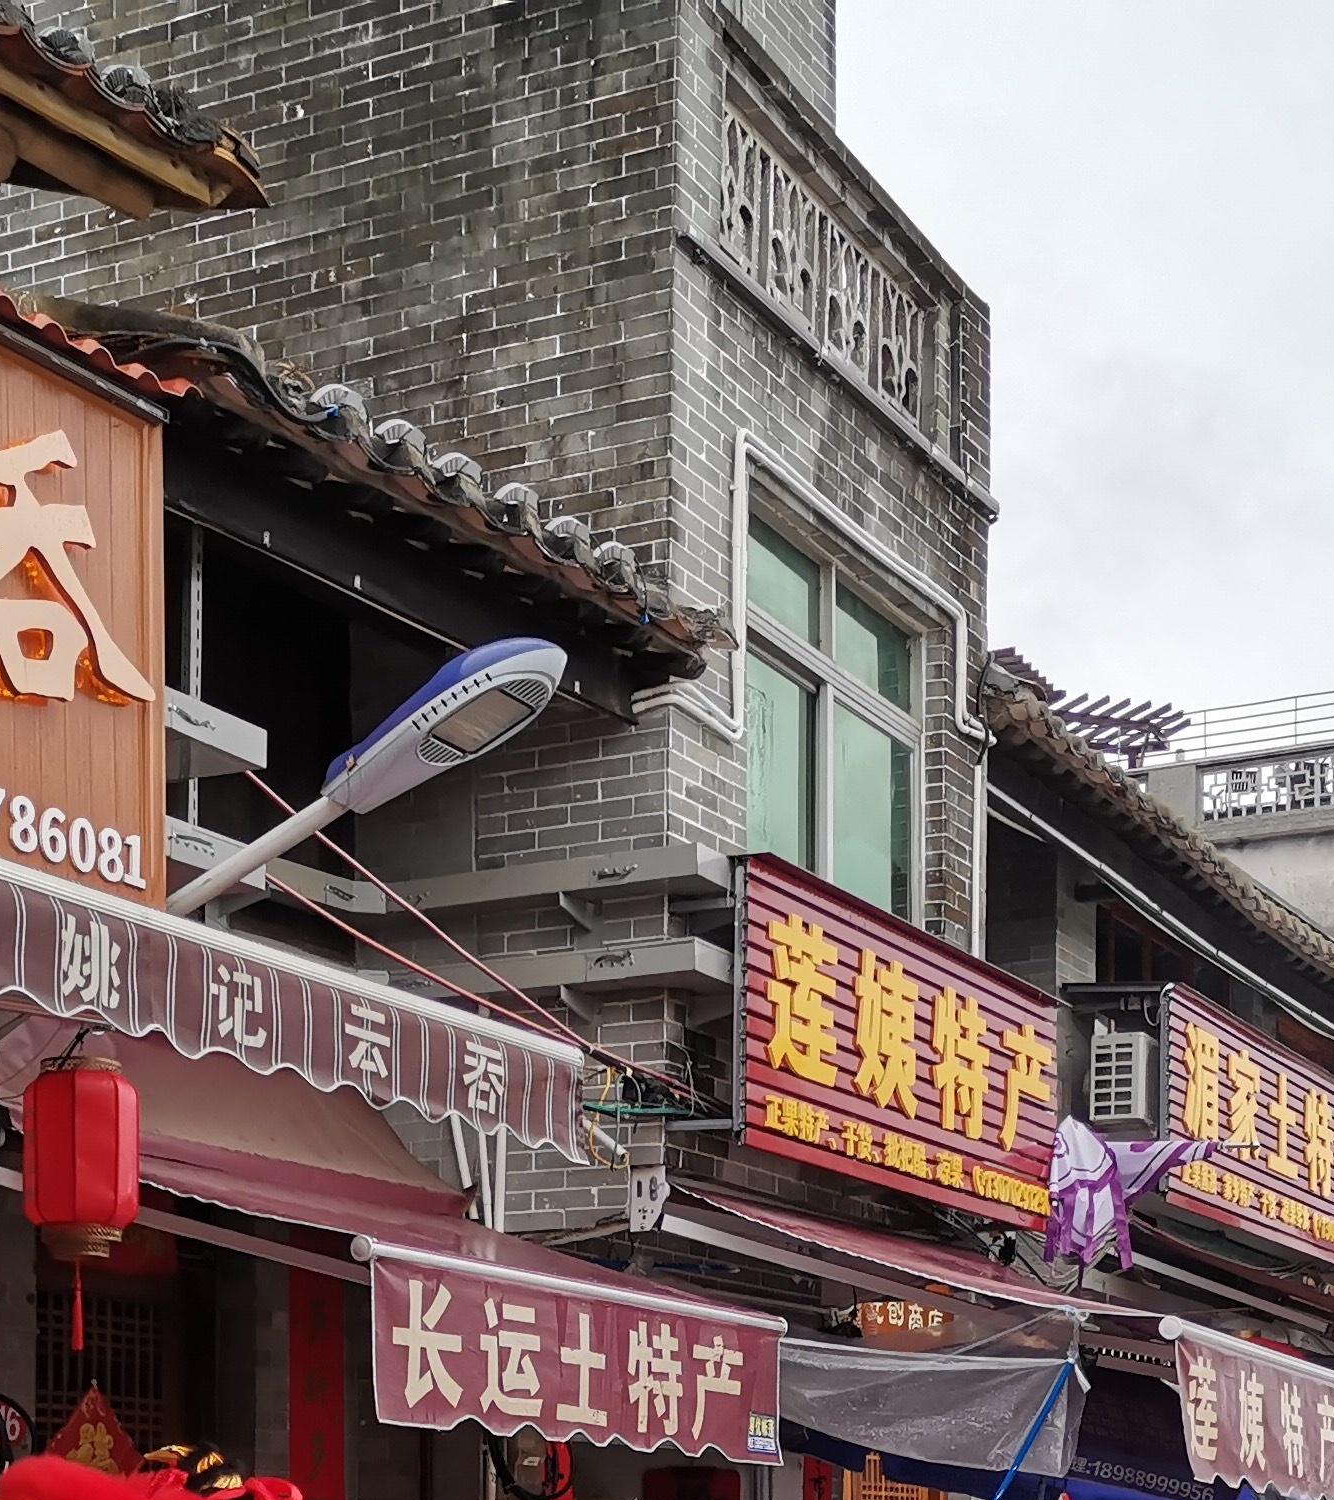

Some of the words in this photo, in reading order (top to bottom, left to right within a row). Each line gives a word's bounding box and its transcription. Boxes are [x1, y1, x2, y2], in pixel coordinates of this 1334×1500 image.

[766, 913, 1052, 1151] 莲姨特产
[392, 1278, 744, 1441] 长运土特产
[1188, 1356, 1331, 1483] 莲姨特产
